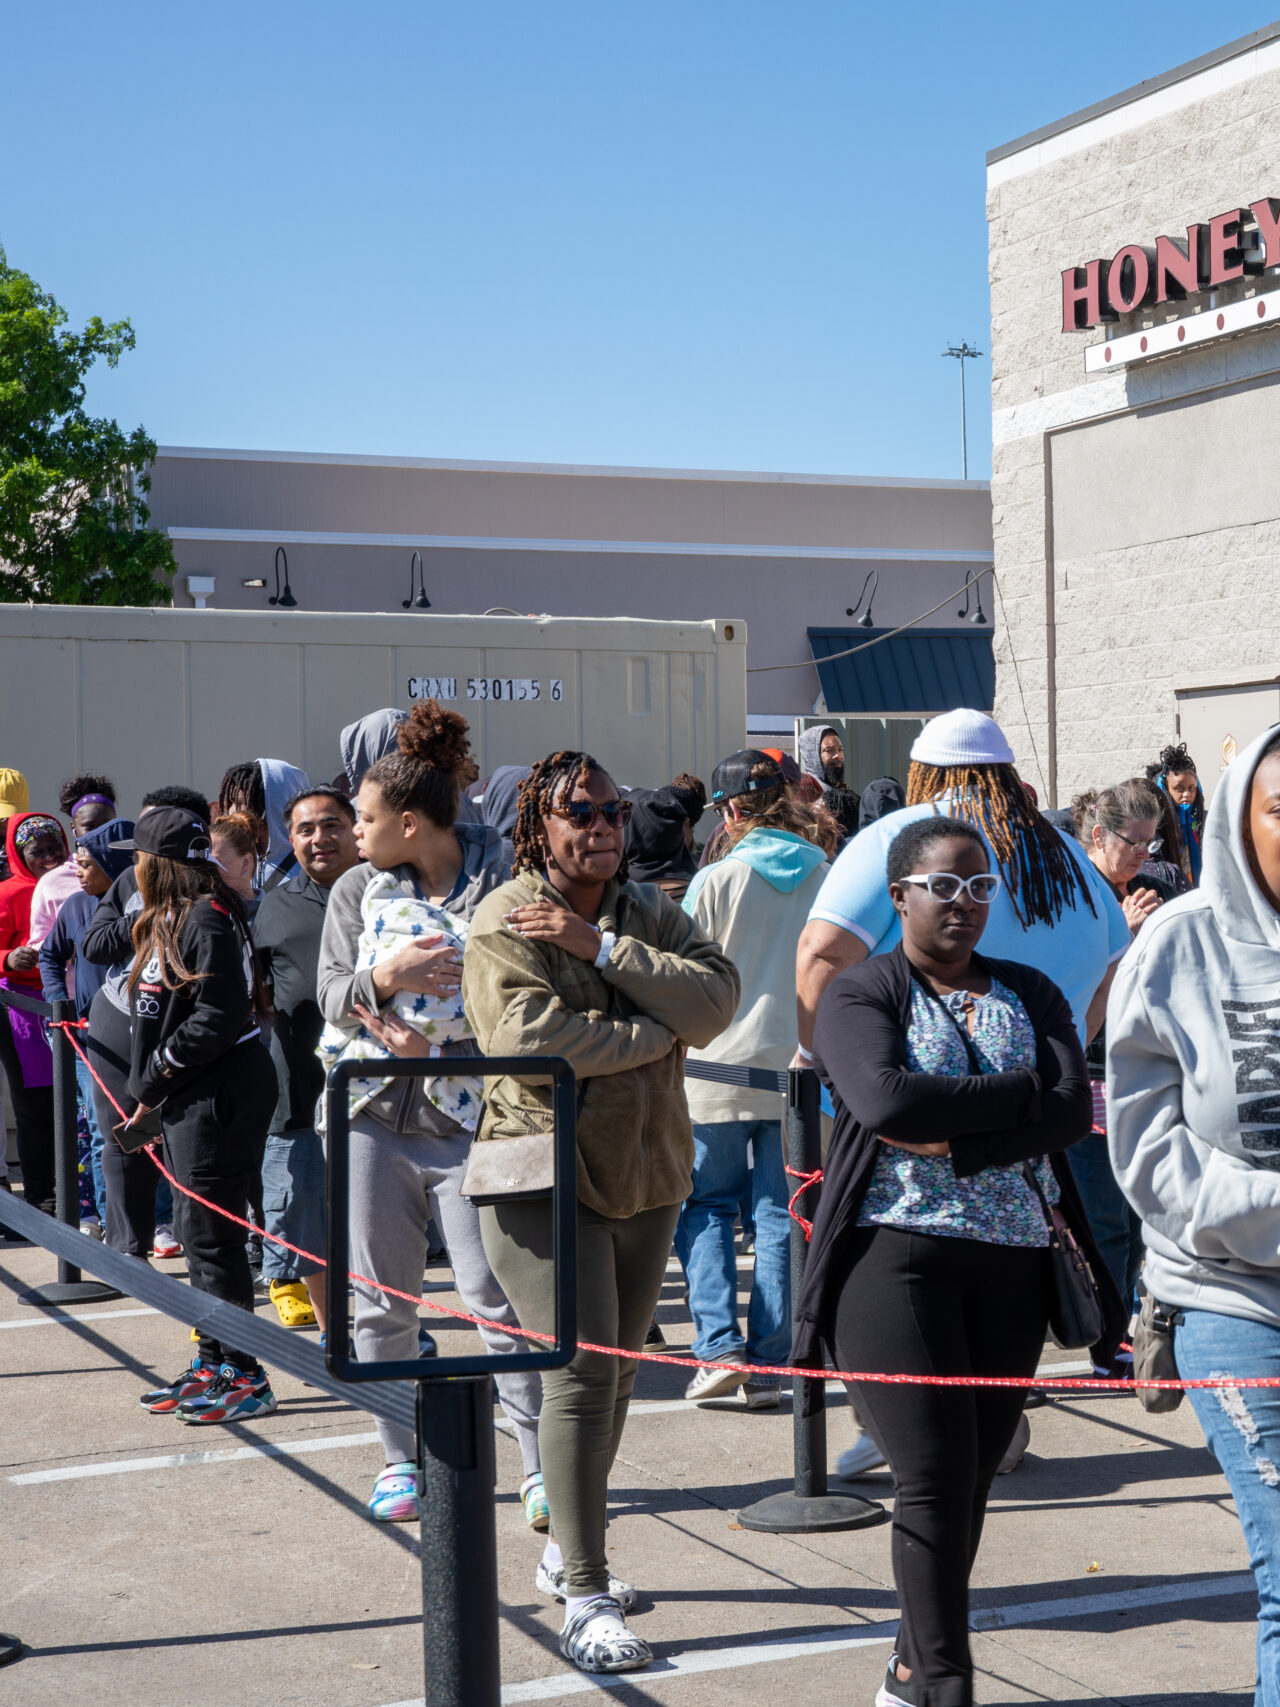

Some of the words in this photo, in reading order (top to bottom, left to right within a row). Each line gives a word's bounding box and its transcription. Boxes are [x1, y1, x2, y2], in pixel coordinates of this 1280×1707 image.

[408, 678, 457, 699] CRXU
[467, 679, 540, 701] 530155
[552, 681, 561, 701] 6
